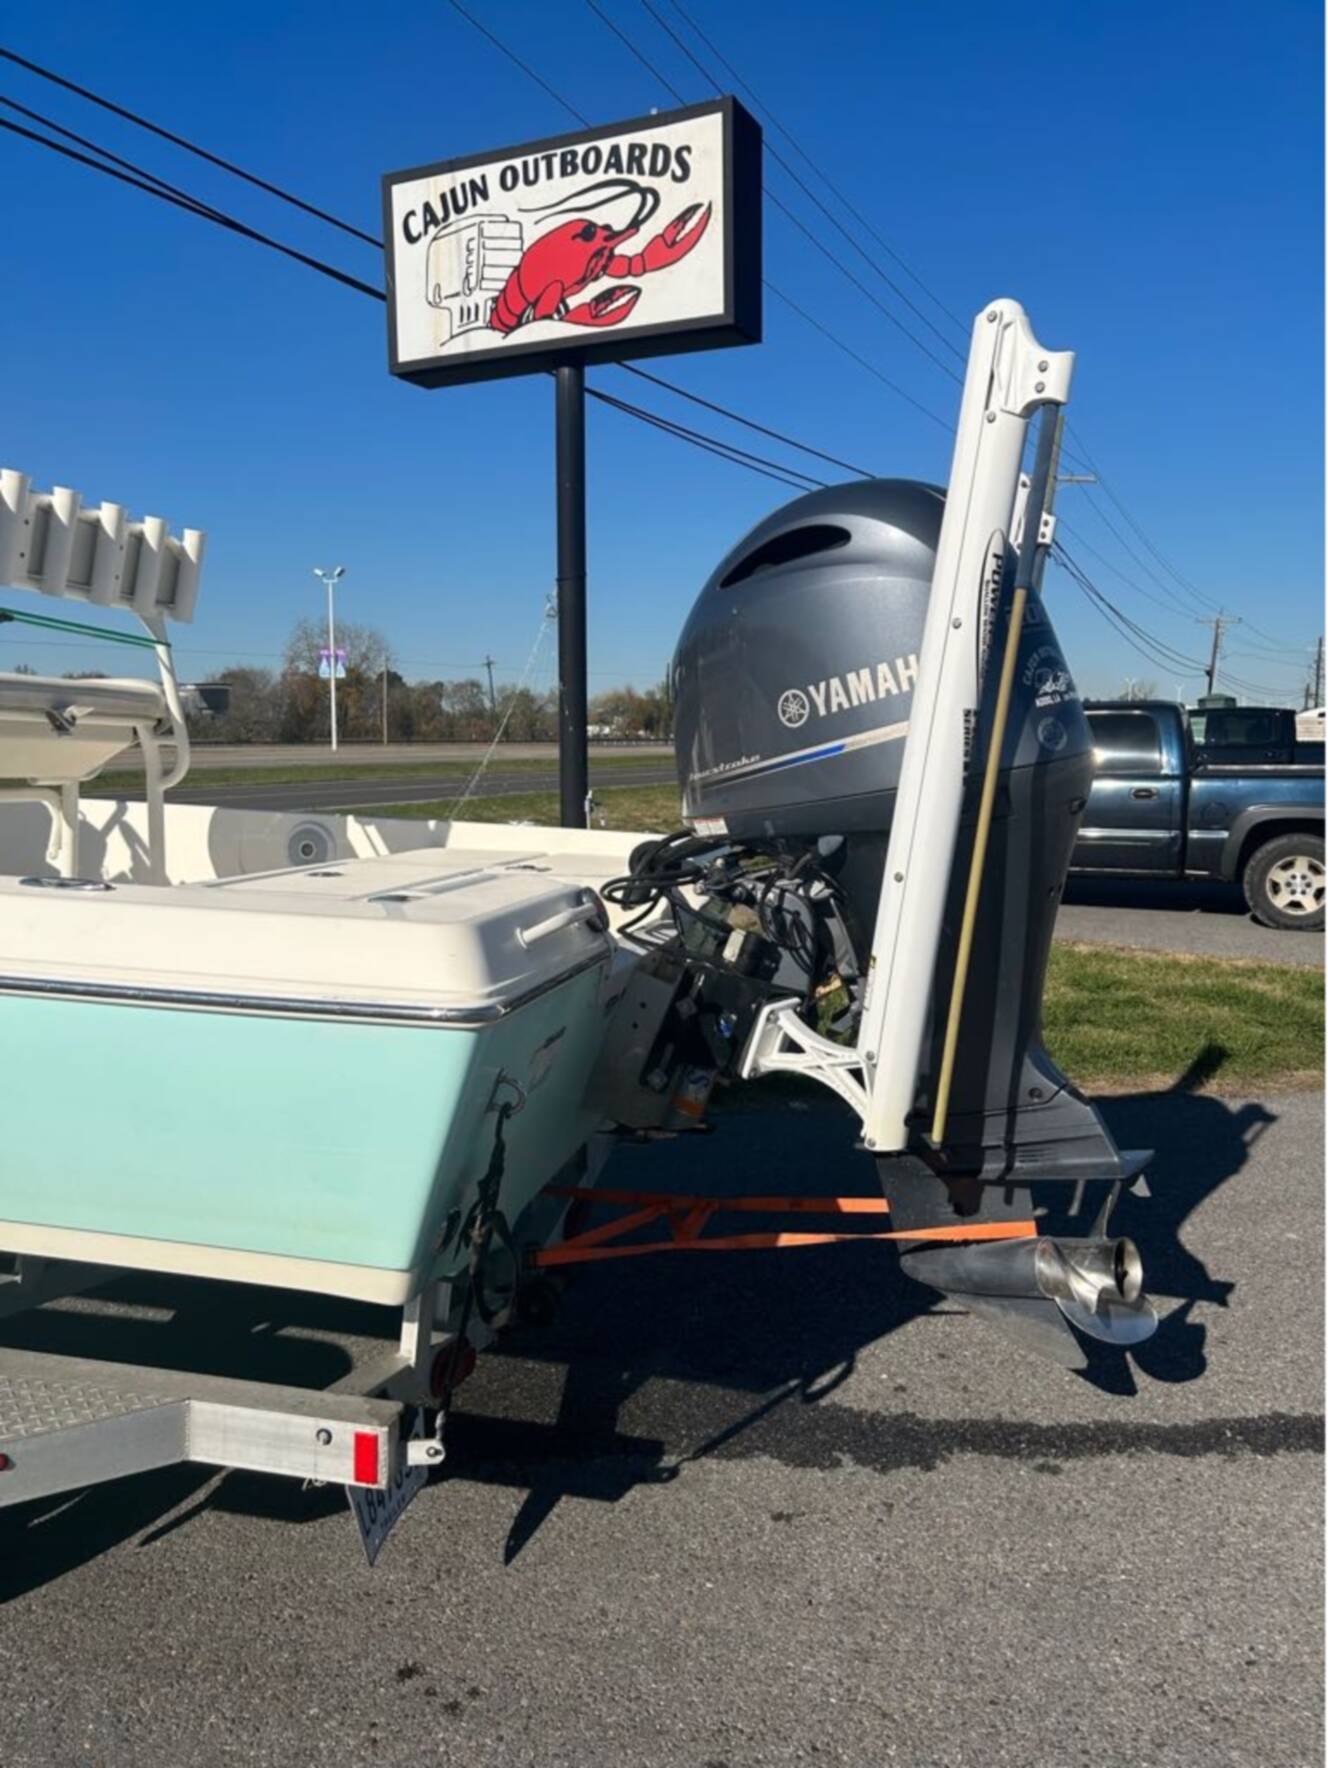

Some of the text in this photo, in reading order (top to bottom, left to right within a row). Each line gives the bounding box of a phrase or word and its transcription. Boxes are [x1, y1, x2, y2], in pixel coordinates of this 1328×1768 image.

[402, 142, 692, 244] CAJUN OUTBOARDS
[807, 653, 919, 717] YAMAH
